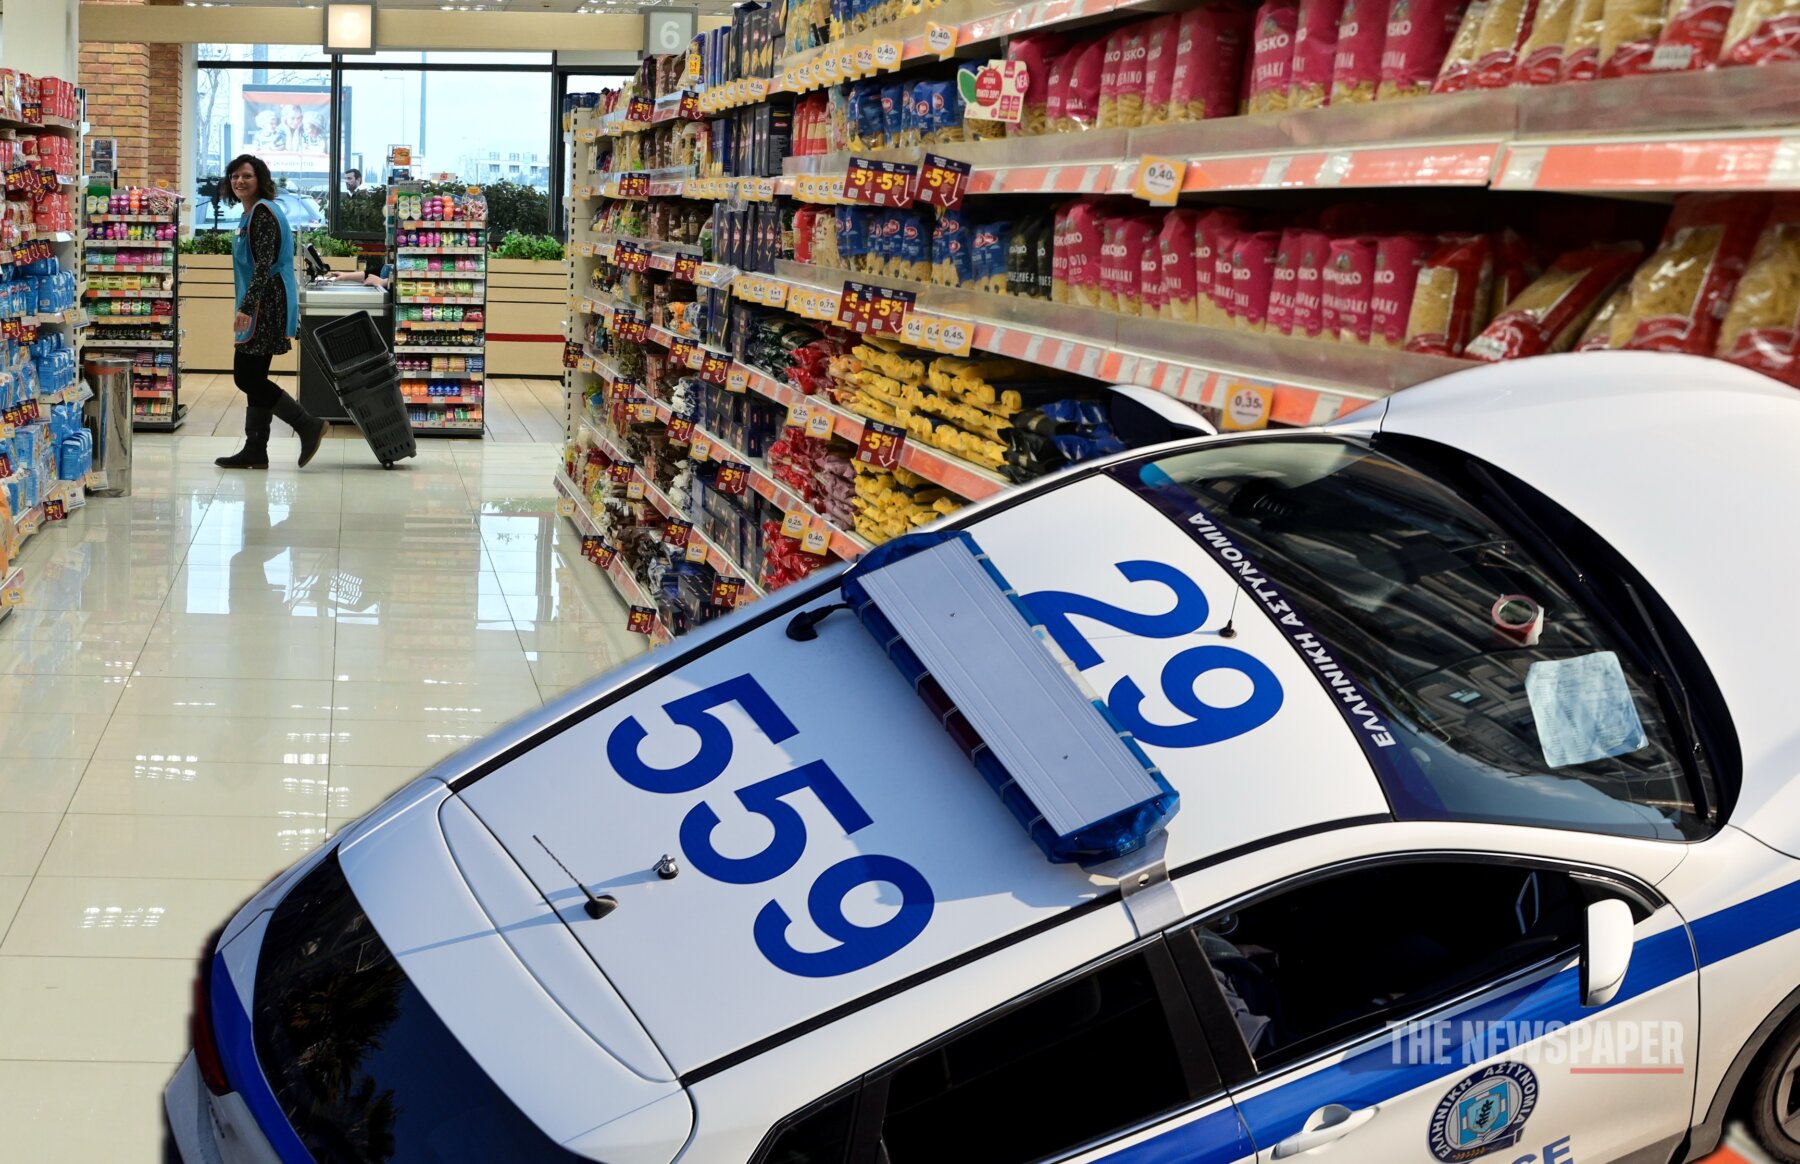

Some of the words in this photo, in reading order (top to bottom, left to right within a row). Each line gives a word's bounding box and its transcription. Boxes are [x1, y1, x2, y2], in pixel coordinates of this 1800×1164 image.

[660, 21, 680, 49] 6
[876, 172, 905, 191] -5%
[925, 168, 956, 188] -5%
[875, 298, 903, 317] -5%
[706, 358, 724, 372] -5%
[865, 432, 892, 450] -5%
[721, 469, 741, 484] -5%
[1188, 512, 1304, 627] ΑΣΤΥΝΟΜΙΑ
[716, 585, 736, 596] -5%
[632, 613, 649, 624] -5%
[1018, 560, 1284, 748] 29
[1293, 632, 1397, 748] ΕΛΛΗΝΙΚΗ
[606, 673, 935, 978] 559
[1431, 1078, 1473, 1159] ΕΛΛΗΝΙΚΗ
[1483, 1062, 1537, 1125] ΑΣΤΥΝΟΜΙΑ
